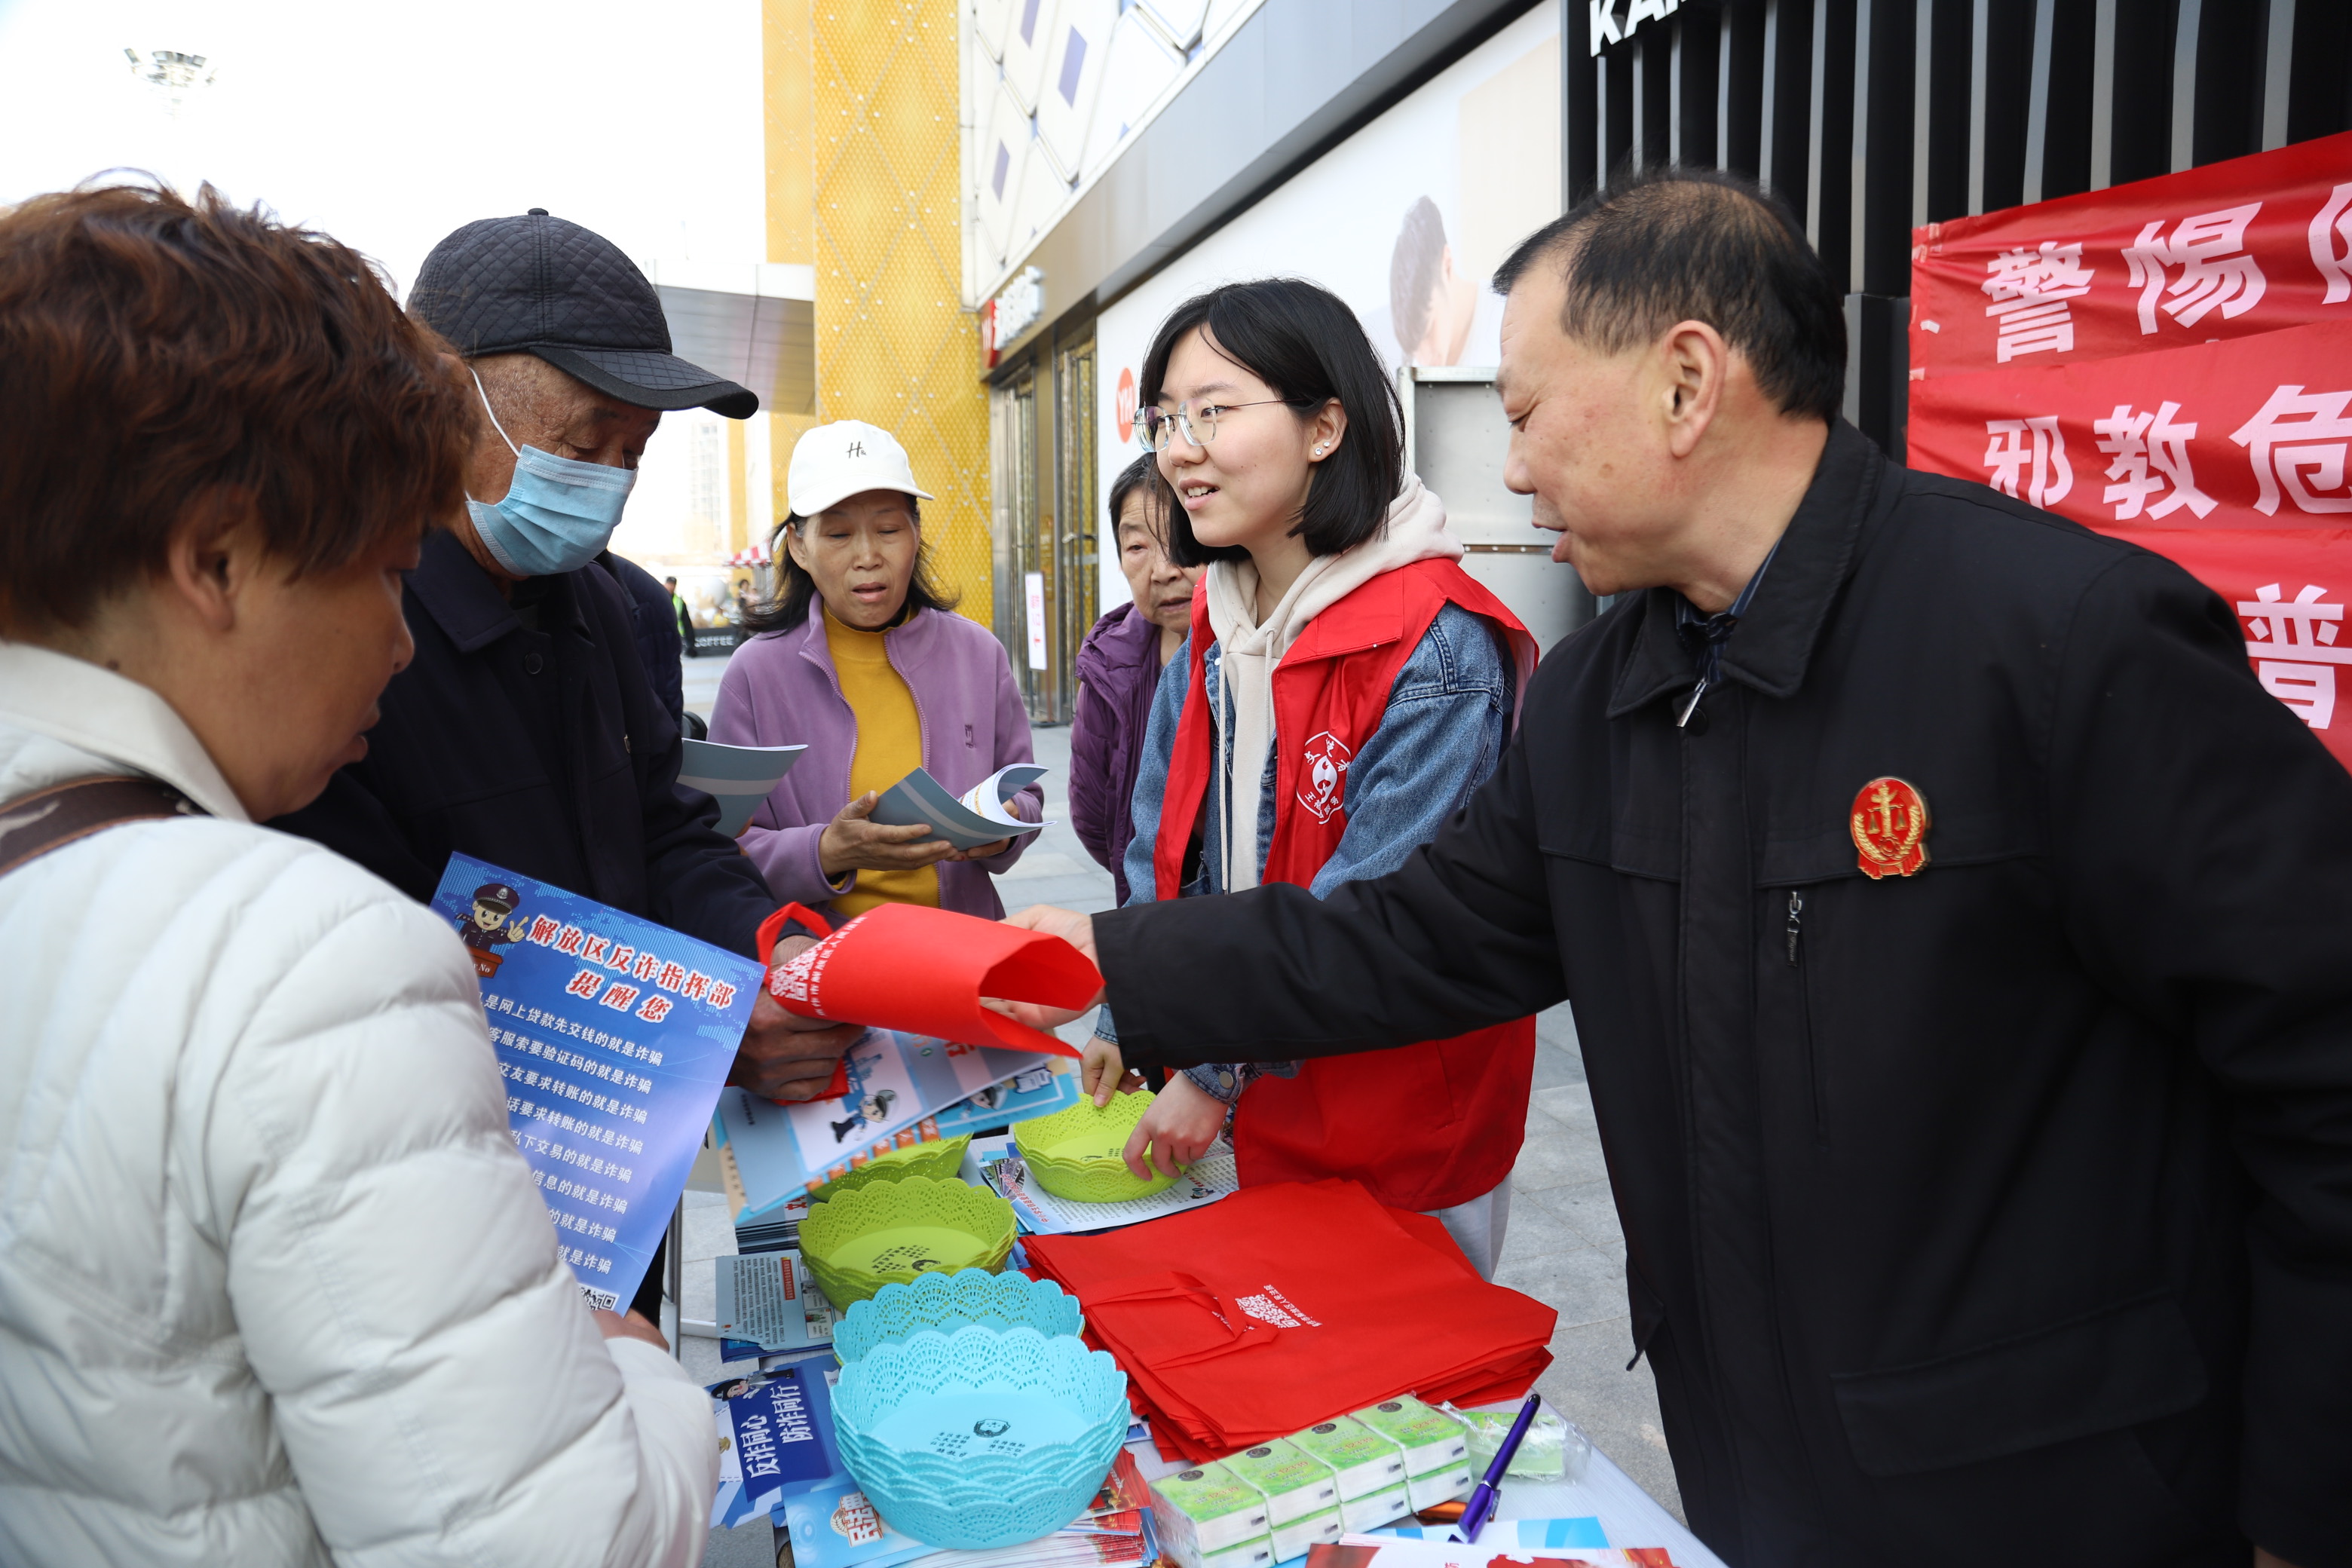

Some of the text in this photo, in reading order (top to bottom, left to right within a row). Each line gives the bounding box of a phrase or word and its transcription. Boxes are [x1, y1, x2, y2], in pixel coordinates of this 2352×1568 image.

[1983, 384, 2352, 520] 邪教危
[478, 963, 491, 973] No
[526, 915, 737, 1009] 解放区反诈指挥部
[566, 969, 674, 1023] 提醒您
[488, 1026, 652, 1095] 客服索要验证码的就是诈骗
[498, 1061, 648, 1125] 交友要求转账的就是诈骗
[507, 1096, 643, 1155] 话要求转账的就是诈骗
[548, 1208, 617, 1244] 的就是诈骗
[556, 1245, 612, 1275] 就是诈骗
[769, 1385, 814, 1444] 防诈同行
[740, 1414, 782, 1479] 反诈同心
[1279, 1460, 1309, 1475] 12339
[1344, 1437, 1374, 1450] 12339
[1207, 1486, 1240, 1499] 12339
